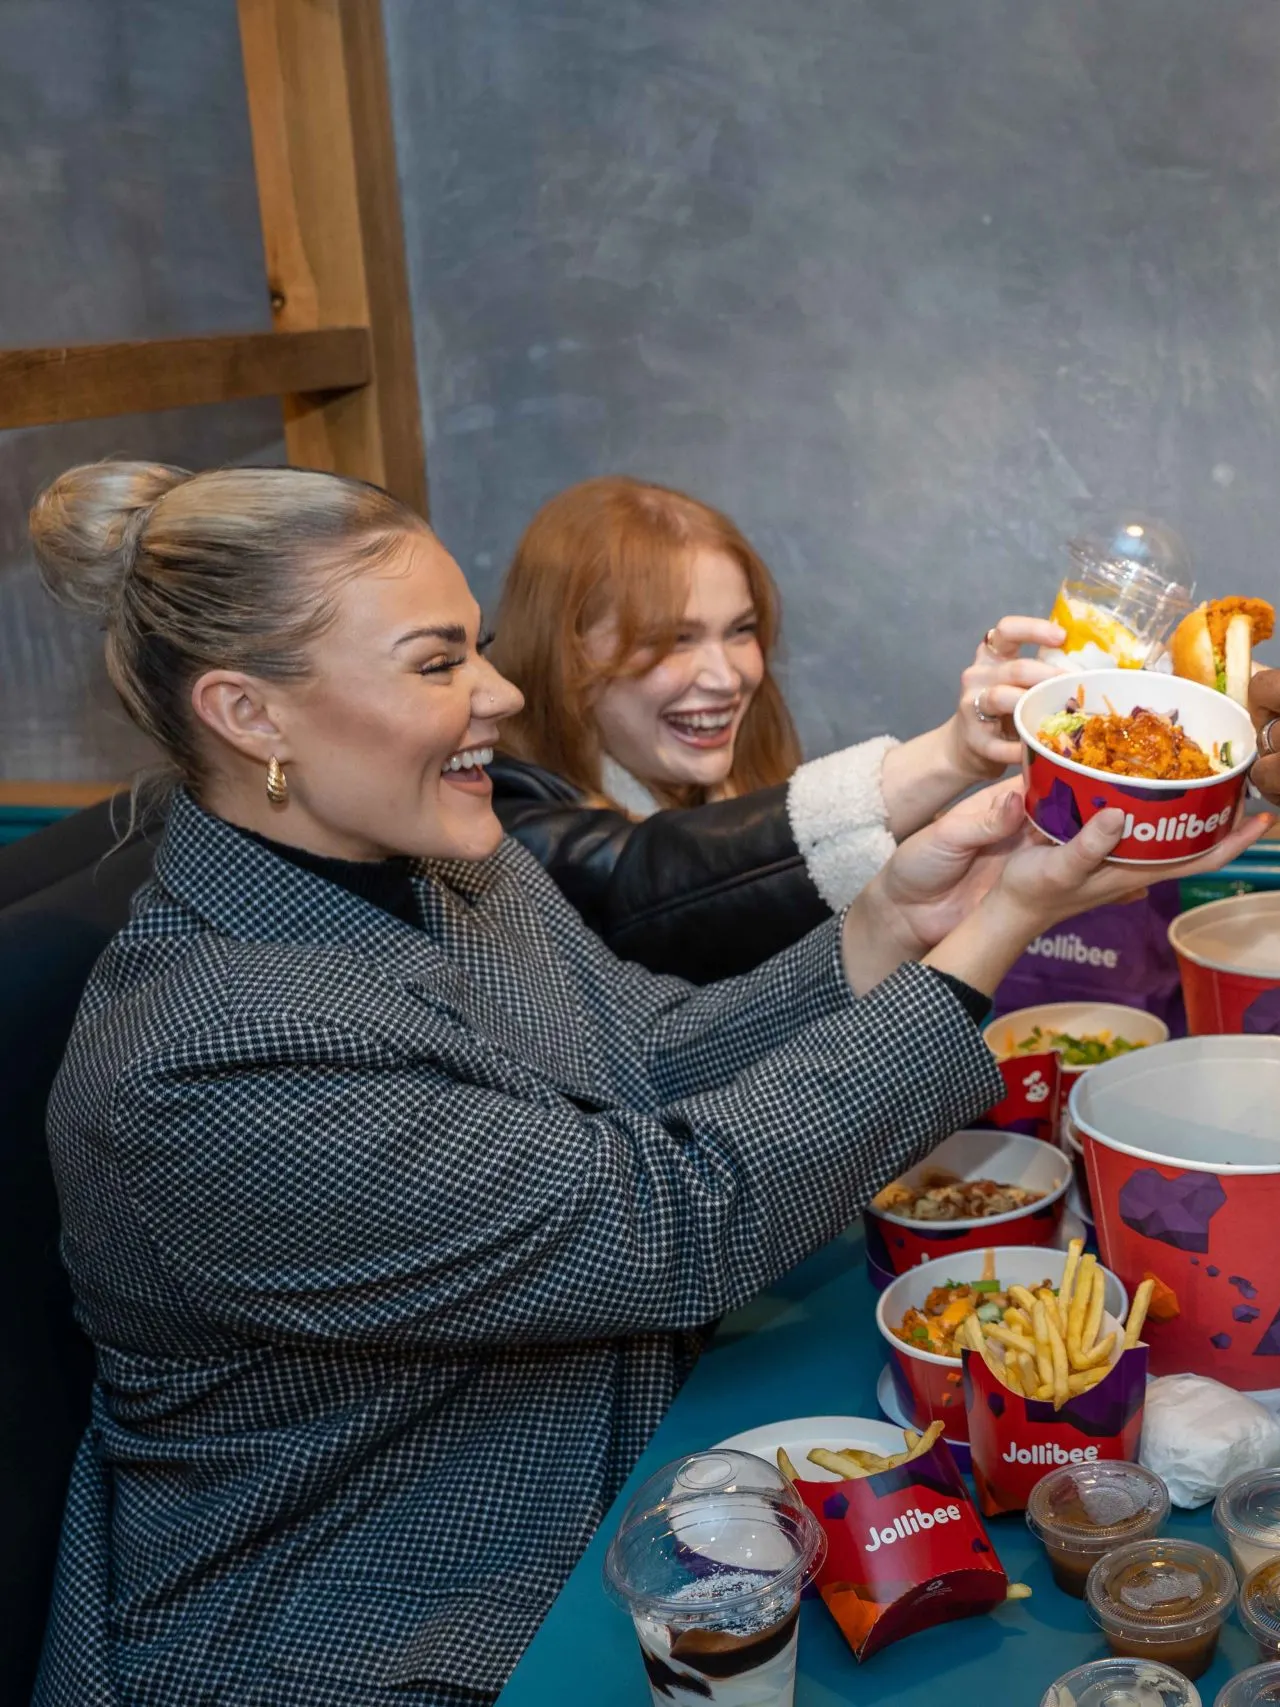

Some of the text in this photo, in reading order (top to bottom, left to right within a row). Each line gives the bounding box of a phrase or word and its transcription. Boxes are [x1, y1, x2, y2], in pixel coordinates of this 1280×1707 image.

[1121, 806, 1232, 842] Jollibee
[1027, 933, 1118, 969] Jollibee
[1002, 1441, 1099, 1465] Jollibee
[865, 1504, 961, 1552] Jollibee
